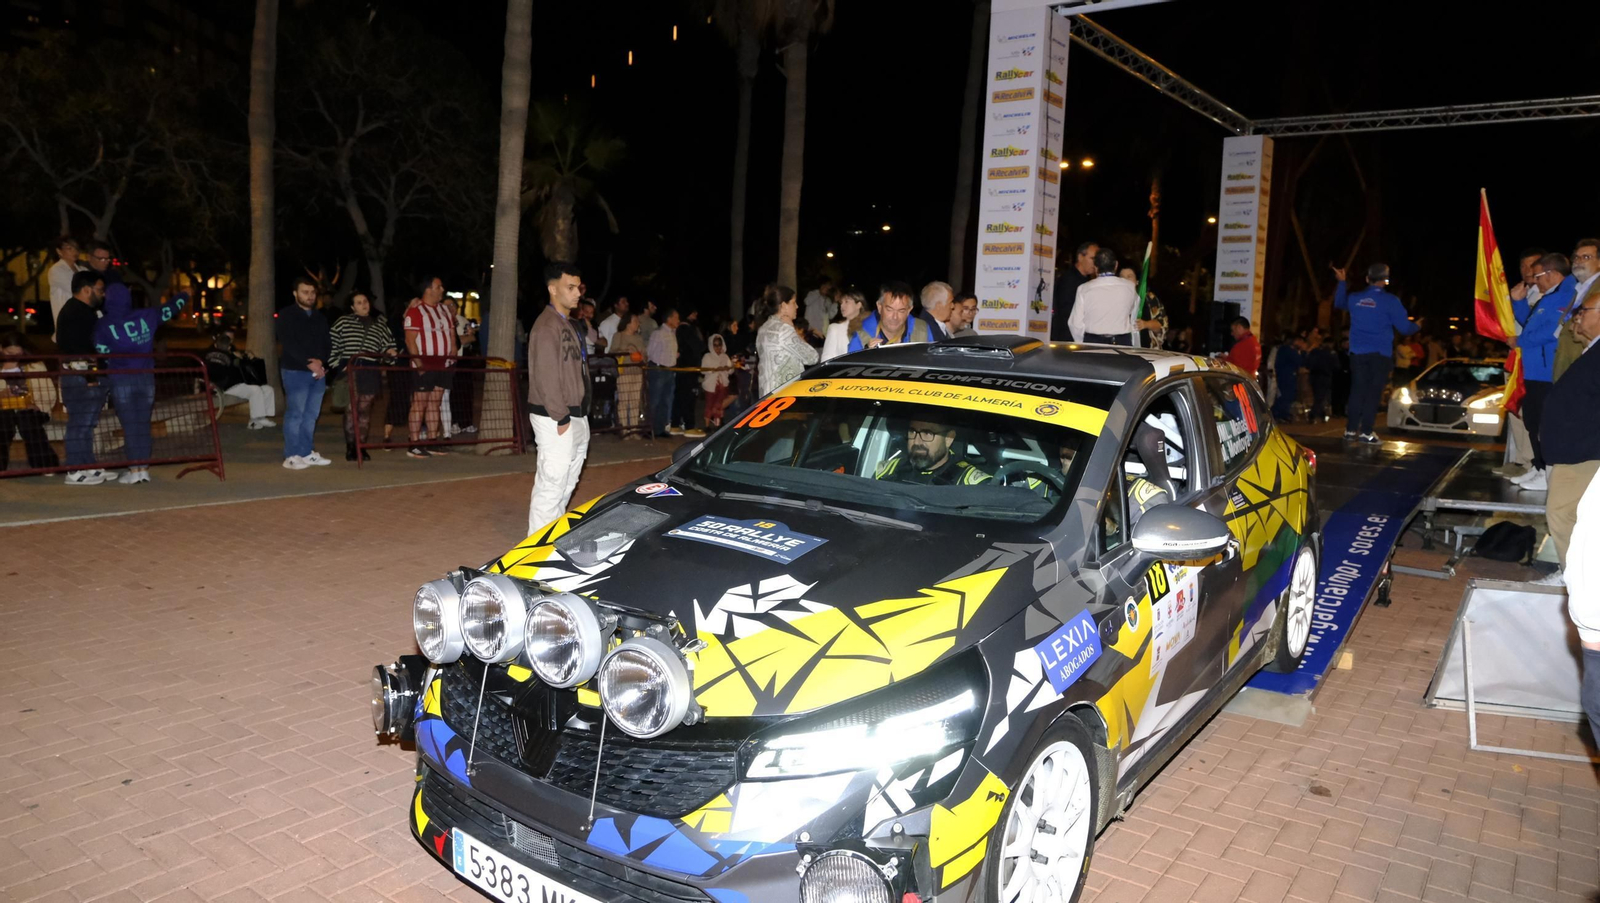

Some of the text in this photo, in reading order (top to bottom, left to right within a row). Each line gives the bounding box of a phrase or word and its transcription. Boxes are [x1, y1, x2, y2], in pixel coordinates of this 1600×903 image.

[996, 69, 1034, 80] Rallycar
[991, 148, 1029, 157] Rallycar
[986, 223, 1025, 233] Rallycar
[981, 299, 1019, 310] Rallycar
[829, 366, 1066, 395] AGR COMPETICION
[836, 385, 1023, 409] AUTOMÓVIL CLUB DE ALMERÍA
[1233, 383, 1258, 434] 18
[733, 396, 796, 429] 18
[696, 520, 806, 548] 50 RALLYE
[753, 520, 777, 529] 18
[1148, 563, 1167, 599] 18
[1060, 643, 1095, 682] ABOGADOS
[470, 845, 531, 903] 5383
